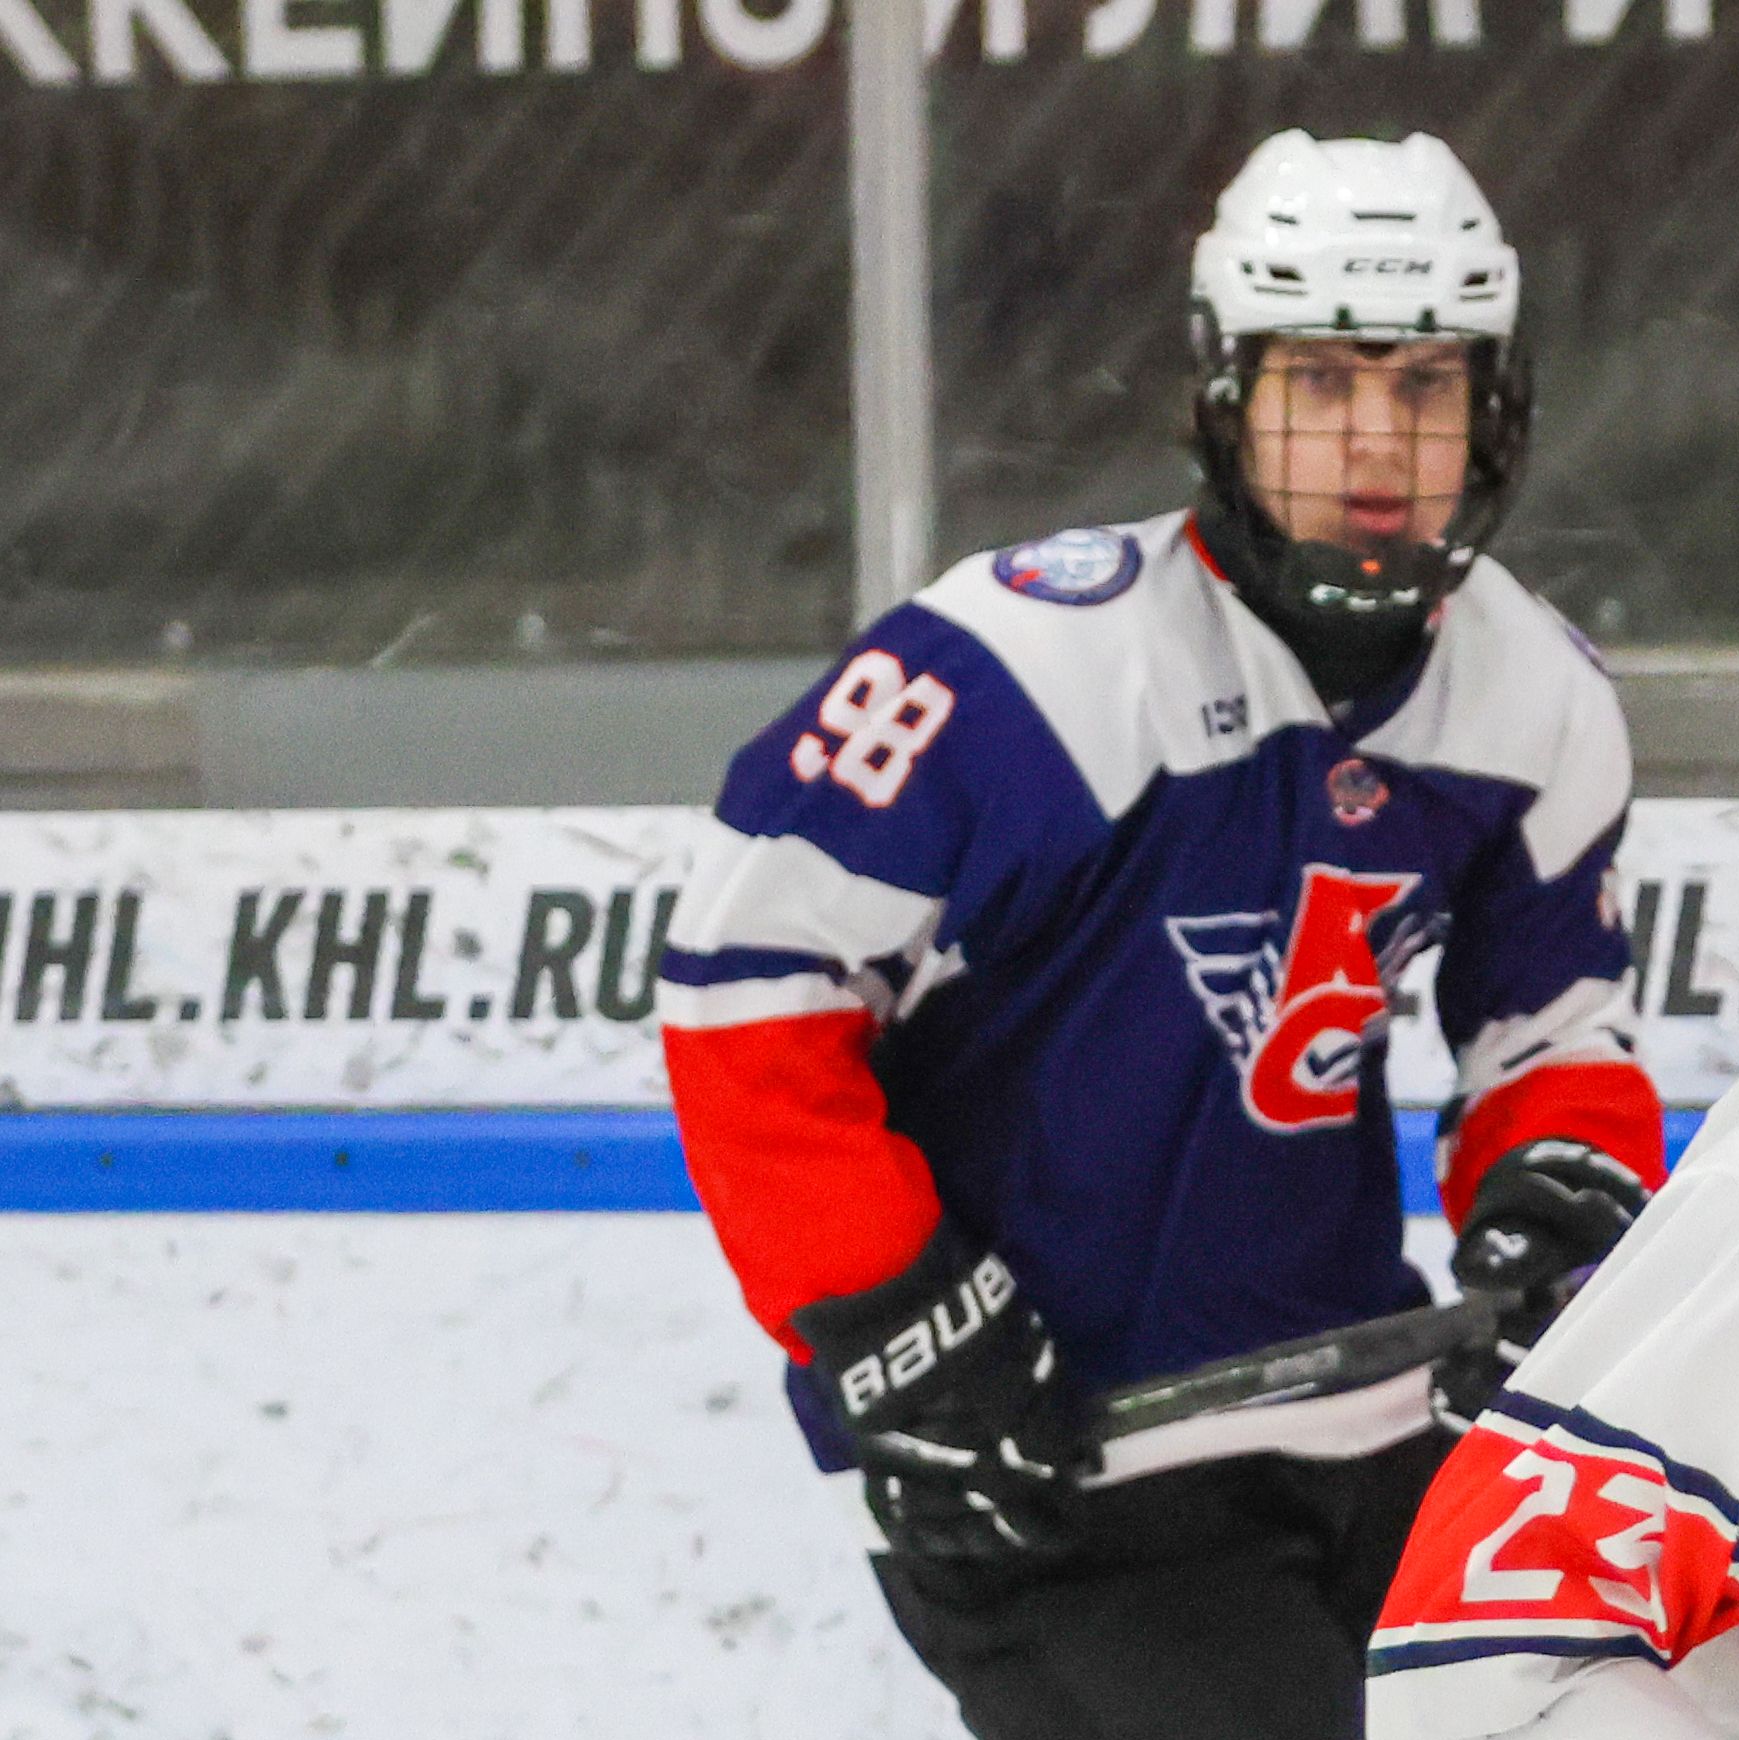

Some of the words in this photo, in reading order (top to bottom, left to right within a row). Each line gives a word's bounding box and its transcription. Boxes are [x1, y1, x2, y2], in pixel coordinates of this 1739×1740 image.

[1343, 257, 1434, 274] CCM
[790, 648, 955, 808] 98
[0, 885, 680, 1021] HL.KHL.RU
[1461, 1448, 1668, 1634] 23
